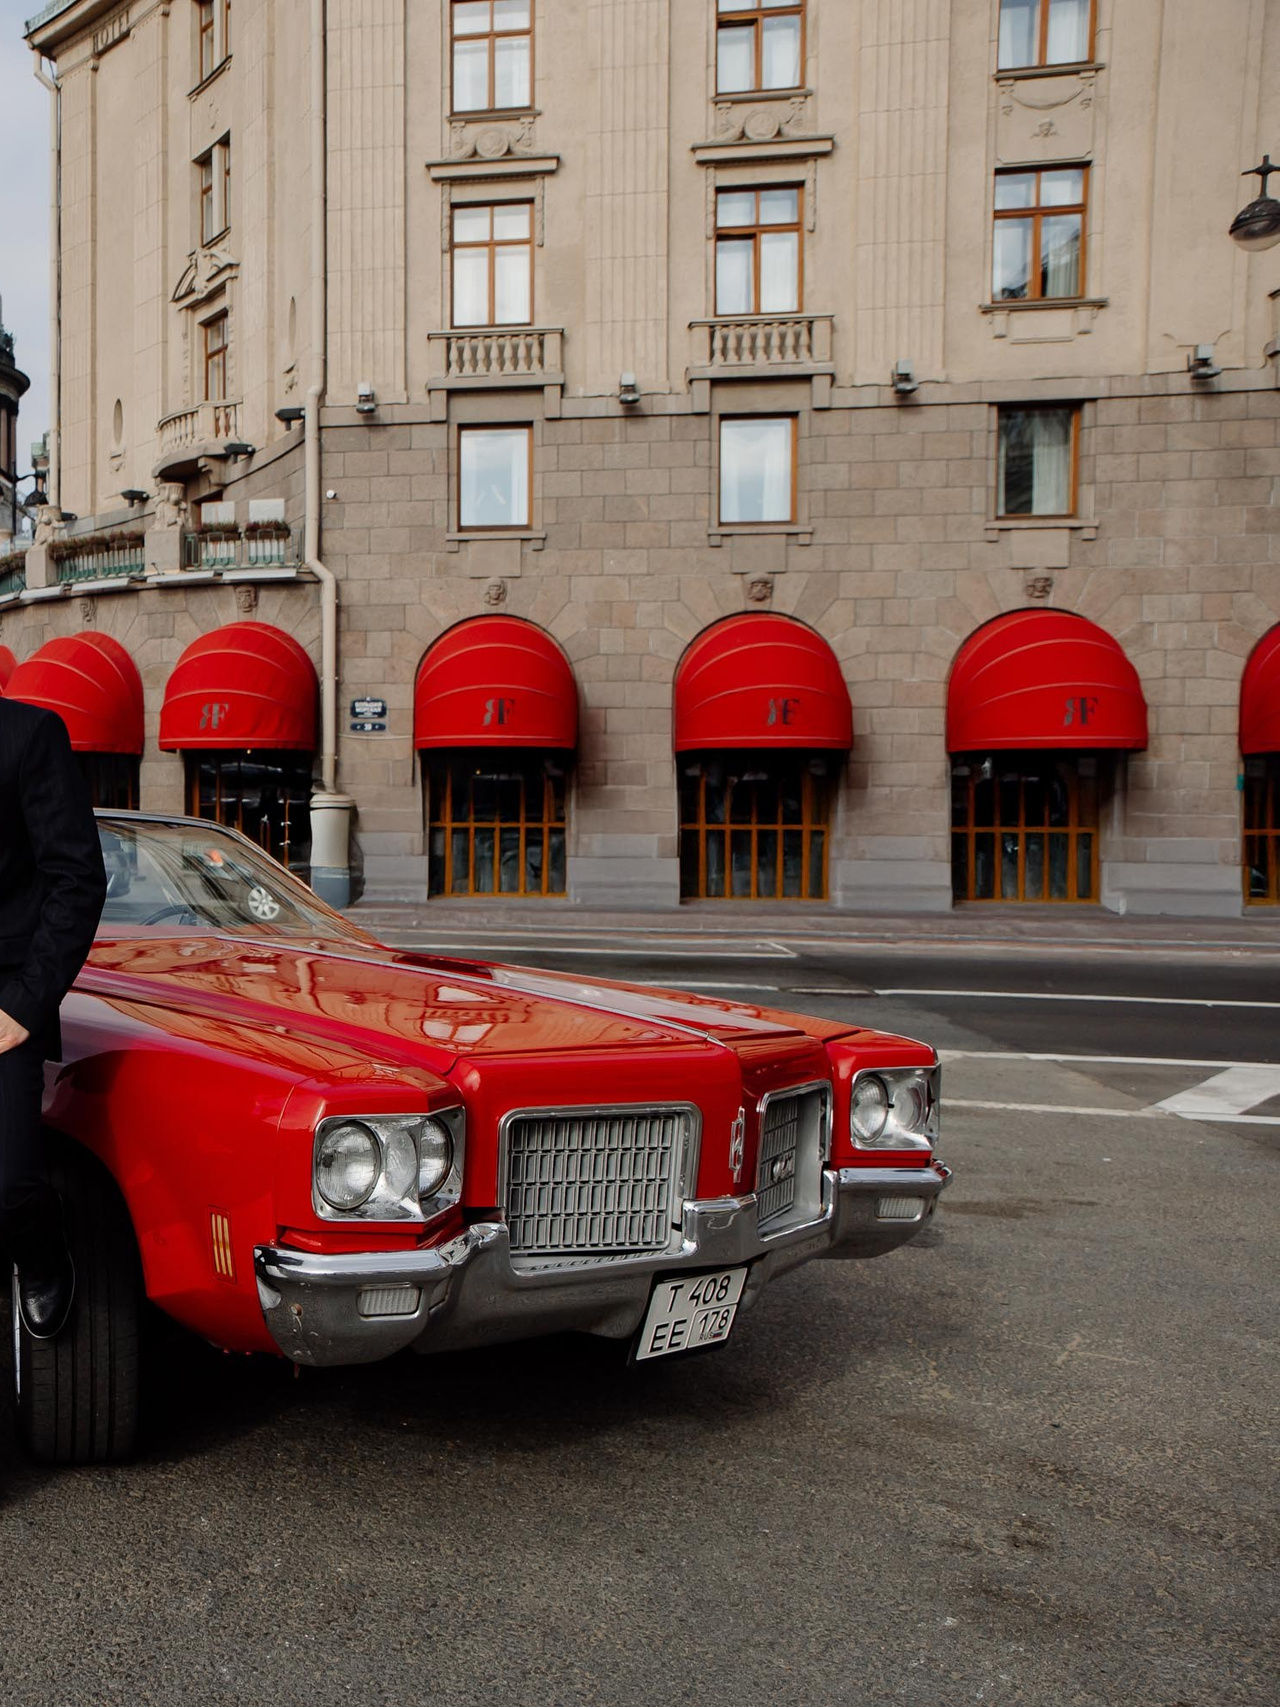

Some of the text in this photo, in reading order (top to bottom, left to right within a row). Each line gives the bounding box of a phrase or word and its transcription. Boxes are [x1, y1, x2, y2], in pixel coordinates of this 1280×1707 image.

[688, 1275, 731, 1308] 408
[699, 1308, 730, 1333] 178
[699, 1332, 713, 1341] RUS
